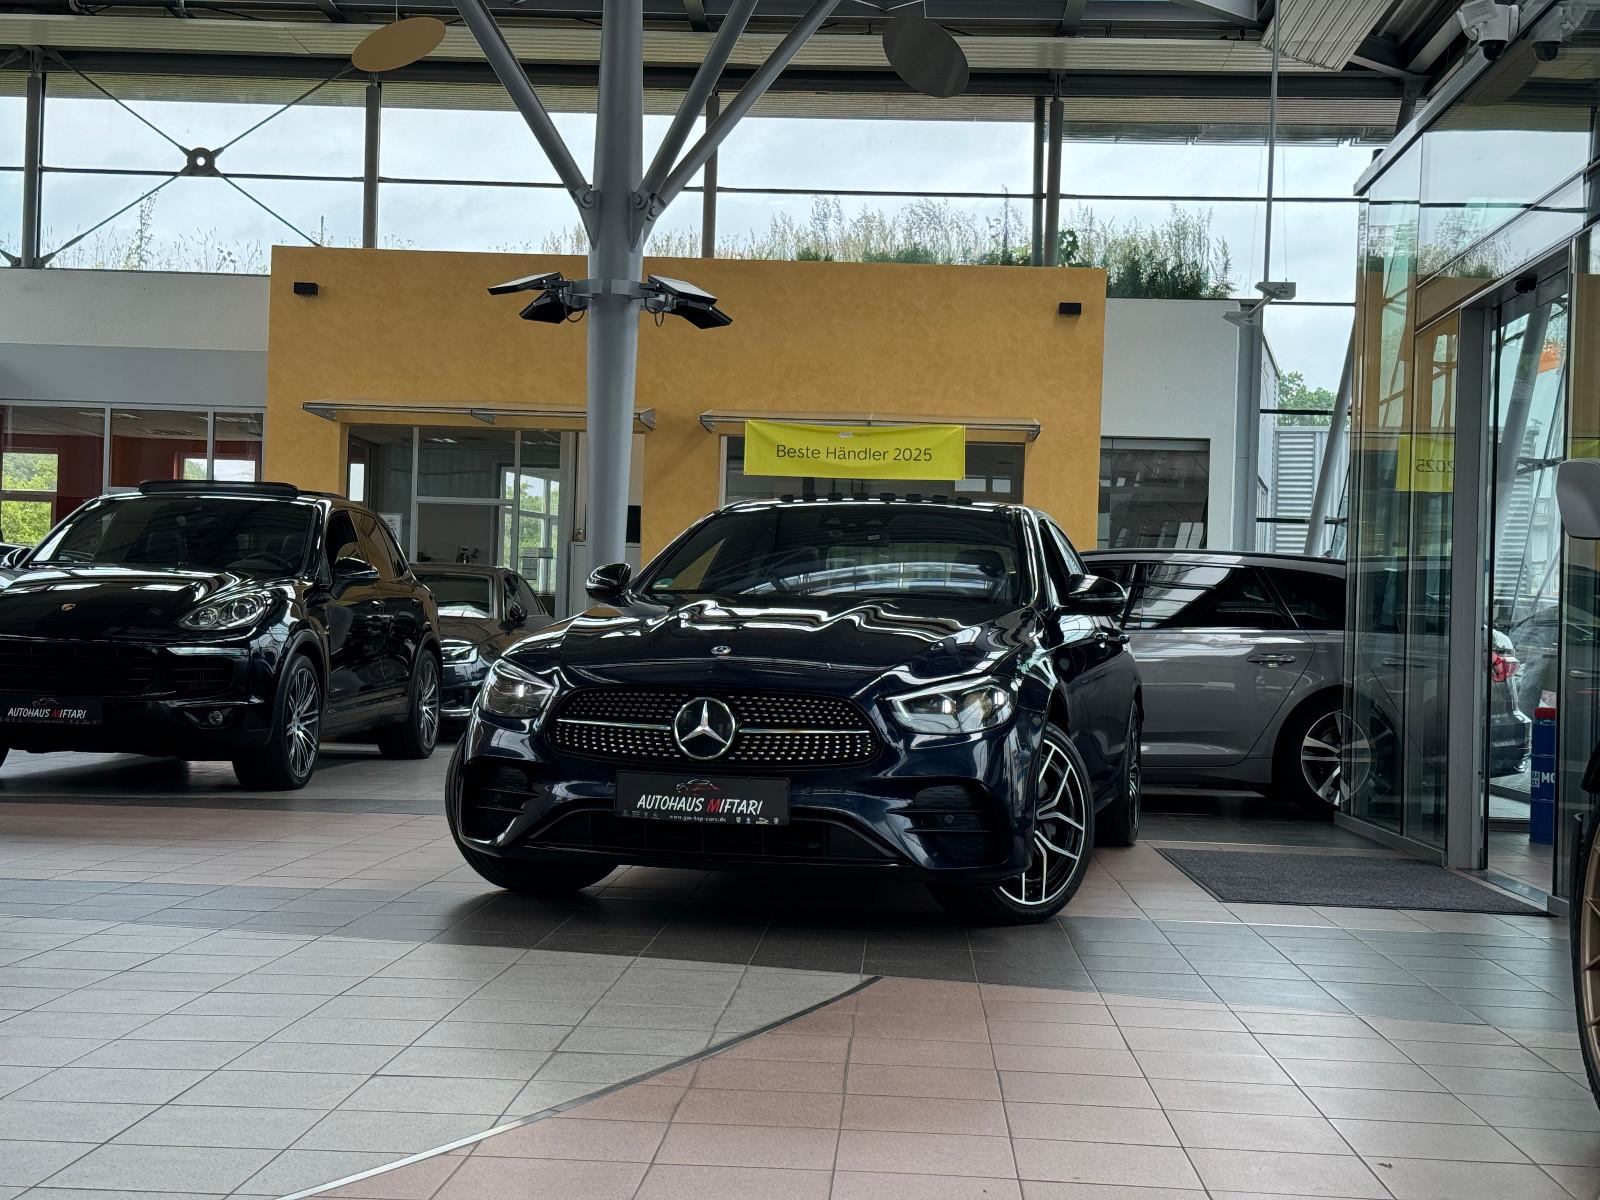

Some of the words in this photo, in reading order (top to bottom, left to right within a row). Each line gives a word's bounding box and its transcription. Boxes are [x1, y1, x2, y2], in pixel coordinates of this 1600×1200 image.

[776, 444, 821, 459] Beste
[826, 445, 889, 461] Händler
[892, 447, 933, 462] 2025
[7, 707, 51, 718] AUTOHAUS
[52, 709, 87, 719] MIFTARI
[637, 795, 705, 812] AUTOHAUS
[706, 798, 763, 815] MIFTARI
